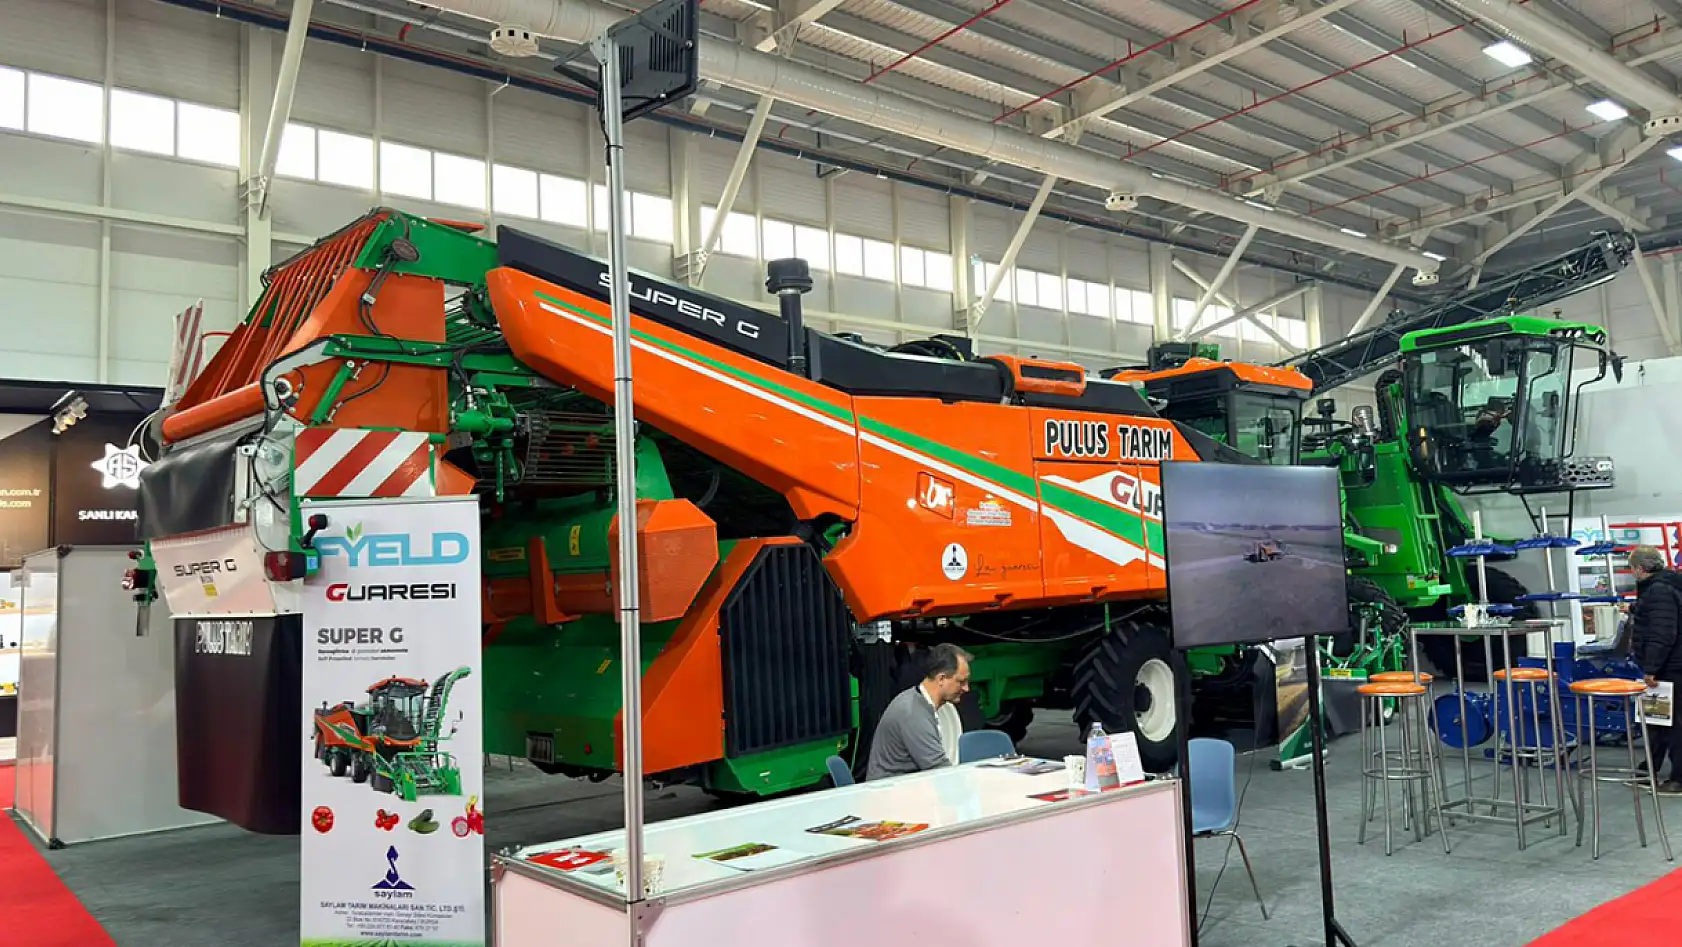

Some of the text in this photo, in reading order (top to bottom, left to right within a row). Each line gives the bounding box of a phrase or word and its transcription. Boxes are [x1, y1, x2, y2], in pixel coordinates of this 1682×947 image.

[598, 271, 760, 339] SUPER G
[1045, 420, 1173, 460] PULUS TARIM
[313, 532, 470, 567] FYELD
[173, 558, 237, 577] SUPER G
[325, 583, 457, 602] GUARESI
[317, 627, 404, 644] SUPER G
[374, 889, 413, 900] saylam
